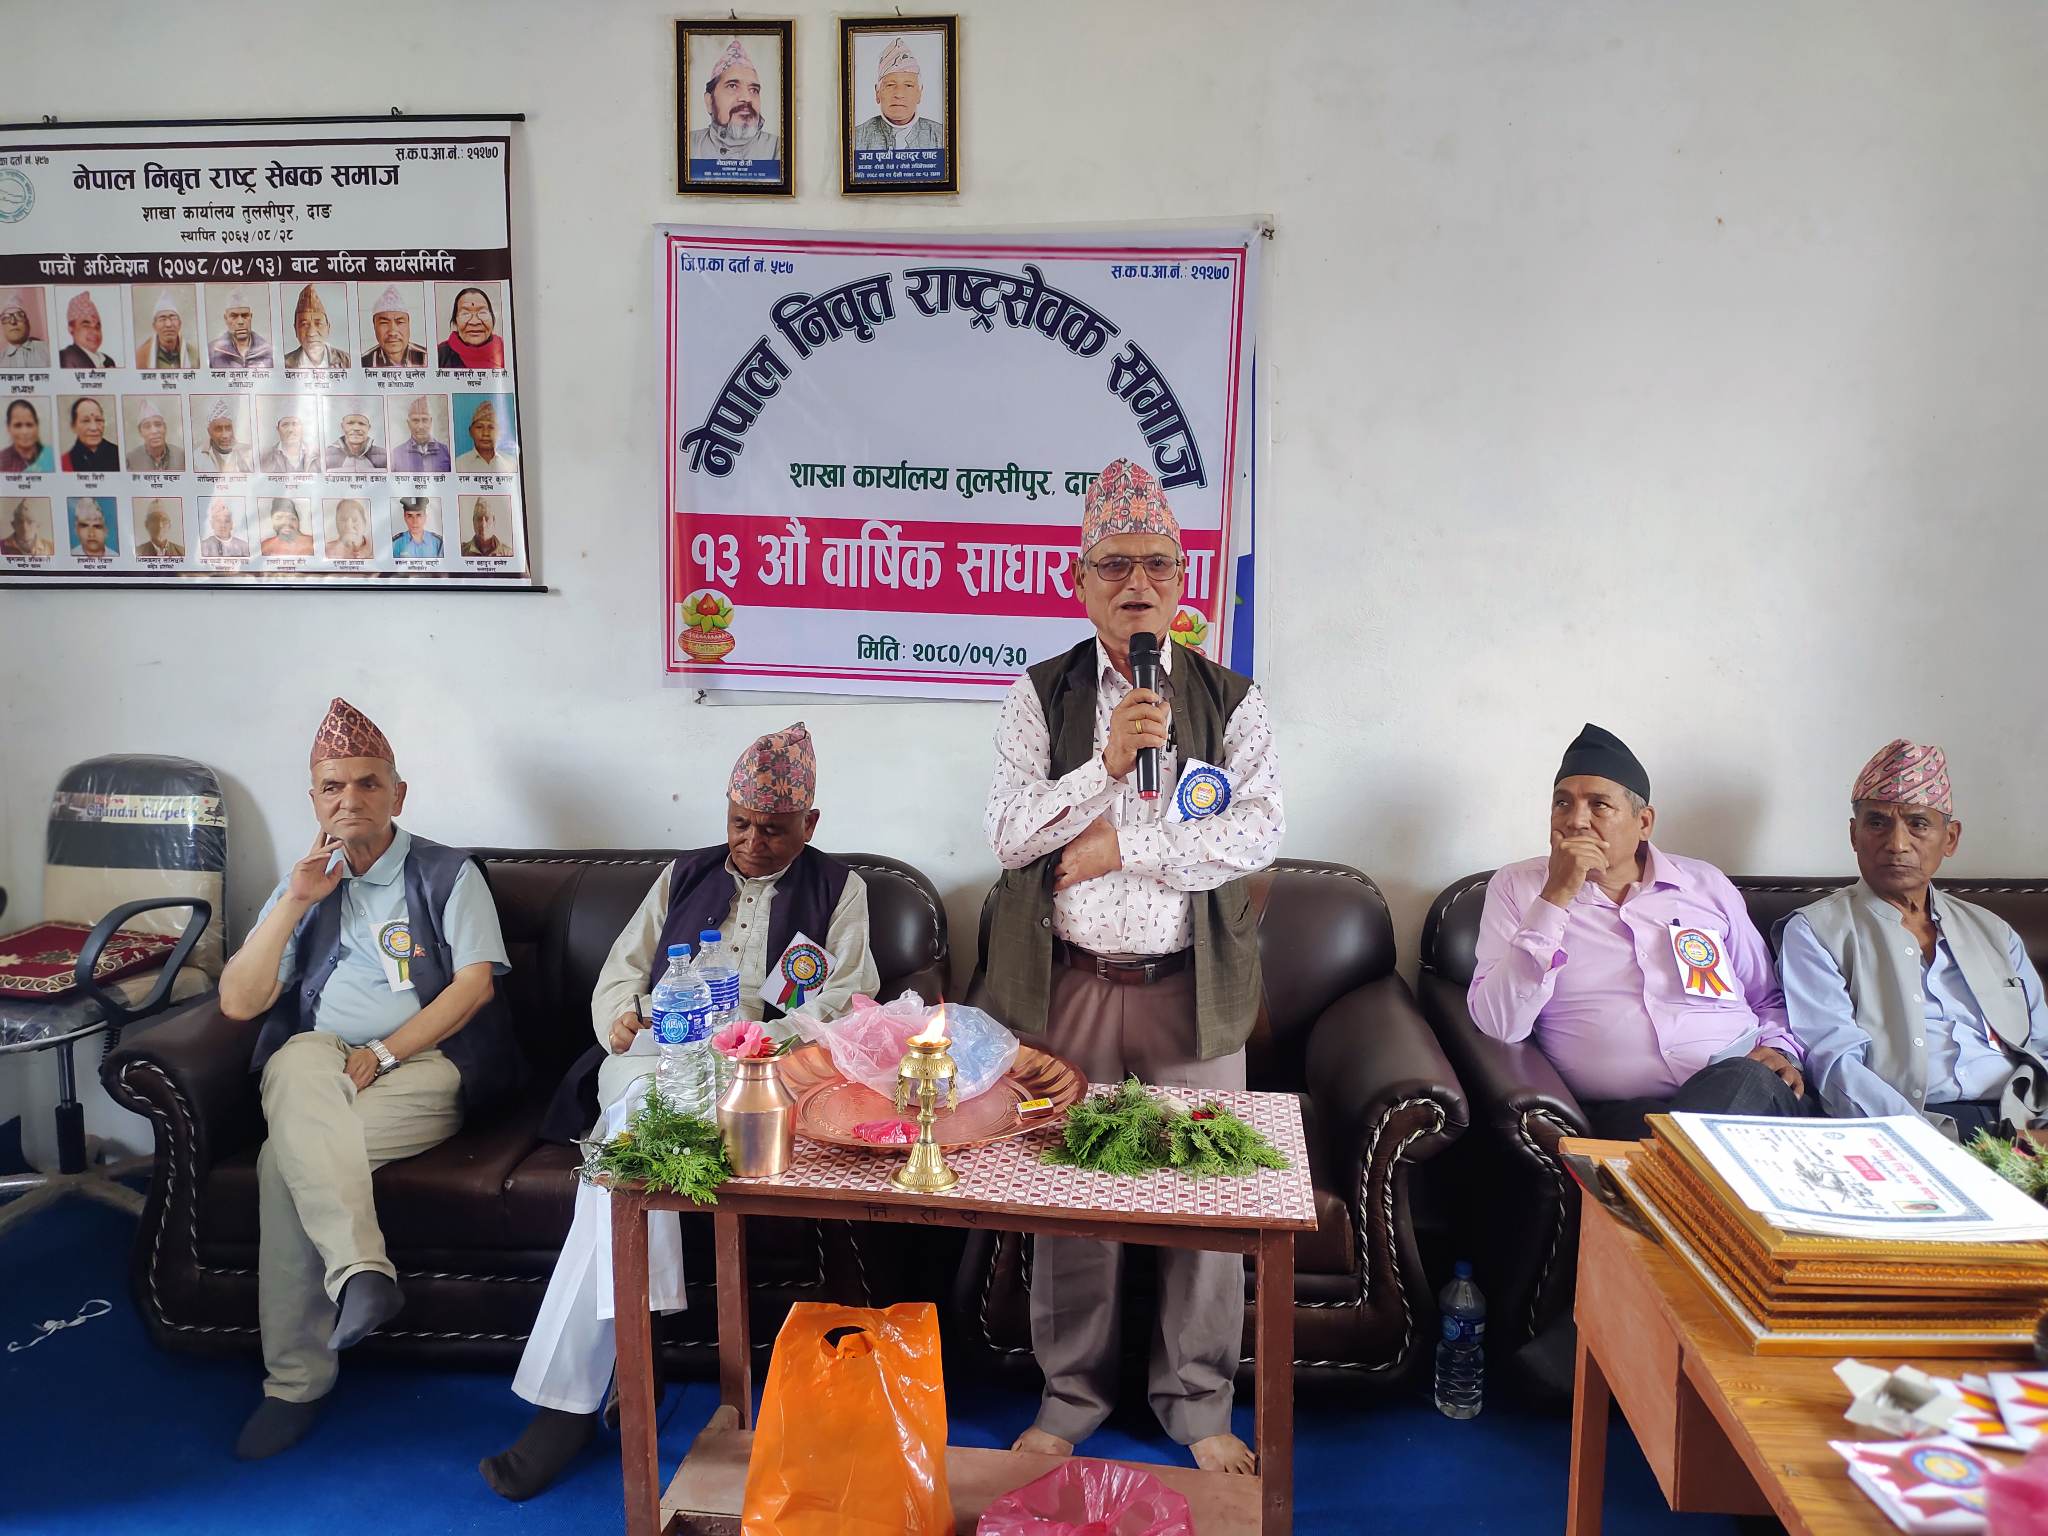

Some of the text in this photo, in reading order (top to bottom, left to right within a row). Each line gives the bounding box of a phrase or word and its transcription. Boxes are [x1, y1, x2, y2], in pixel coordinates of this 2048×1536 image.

[859, 152, 873, 160] जय
[895, 151, 920, 162] बहादुर
[921, 151, 938, 160] शाह
[73, 164, 137, 190] नेपाल
[208, 167, 258, 194] राष्ट्र
[265, 160, 323, 188] सेबक
[331, 165, 400, 187] समाज
[142, 205, 176, 222] शाखा
[182, 201, 236, 221] कार्यालय
[307, 203, 332, 219] दाङ
[180, 227, 216, 242] स्थापित
[84, 252, 149, 278] अधिवेशन
[291, 255, 320, 275] बाट
[327, 250, 368, 274] गठित
[374, 249, 457, 274] कार्यसमिति
[729, 256, 750, 273] दर्ता
[771, 260, 794, 275] ५९७
[1191, 265, 1230, 279] २१२७०
[680, 263, 1208, 491] नेपाल निवृत्त राष्ट्रसेवक समाज
[790, 462, 846, 488] शाखा
[853, 460, 949, 491] कार्यालय
[691, 533, 741, 589] १३
[822, 520, 945, 590] वार्षिक
[956, 542, 1082, 600] साधार
[912, 642, 1028, 667] २०८०/०१/३०
